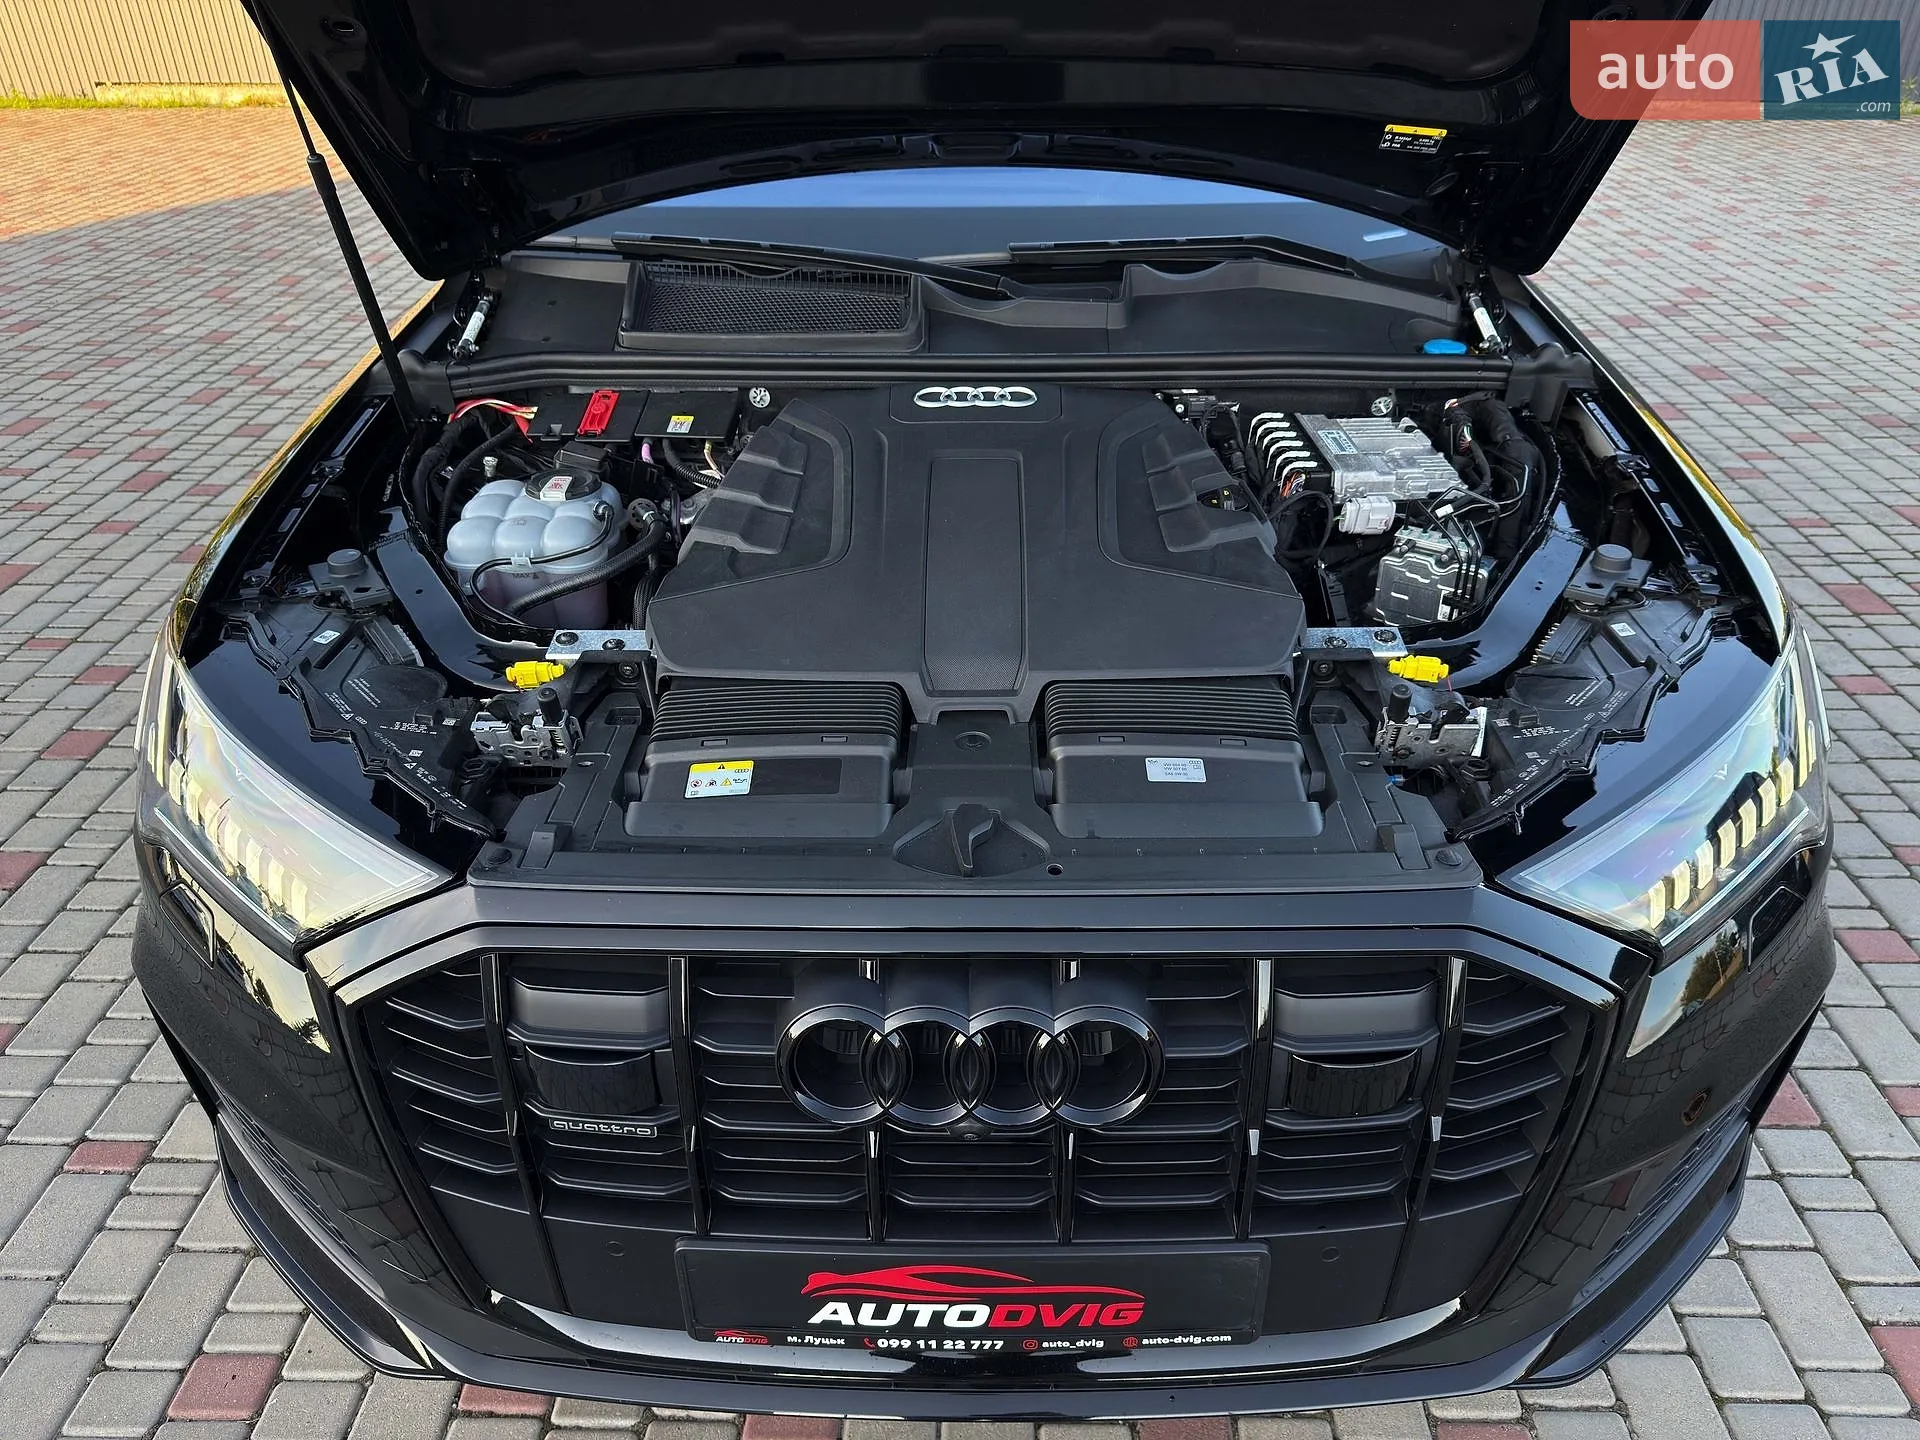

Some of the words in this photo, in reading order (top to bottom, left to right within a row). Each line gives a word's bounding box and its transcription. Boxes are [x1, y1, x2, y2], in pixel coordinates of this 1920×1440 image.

[553, 1120, 652, 1136] quattro
[807, 1301, 1146, 1328] AUTODVIG
[715, 1334, 769, 1345] AUTODVIG
[803, 1335, 846, 1346] Луцьк
[877, 1338, 912, 1349] 099
[916, 1339, 937, 1349] 11
[942, 1339, 966, 1350] 22
[970, 1339, 1004, 1350] 777
[1041, 1338, 1105, 1348] auto_dvig
[1141, 1334, 1232, 1345] auto-dvig.com
